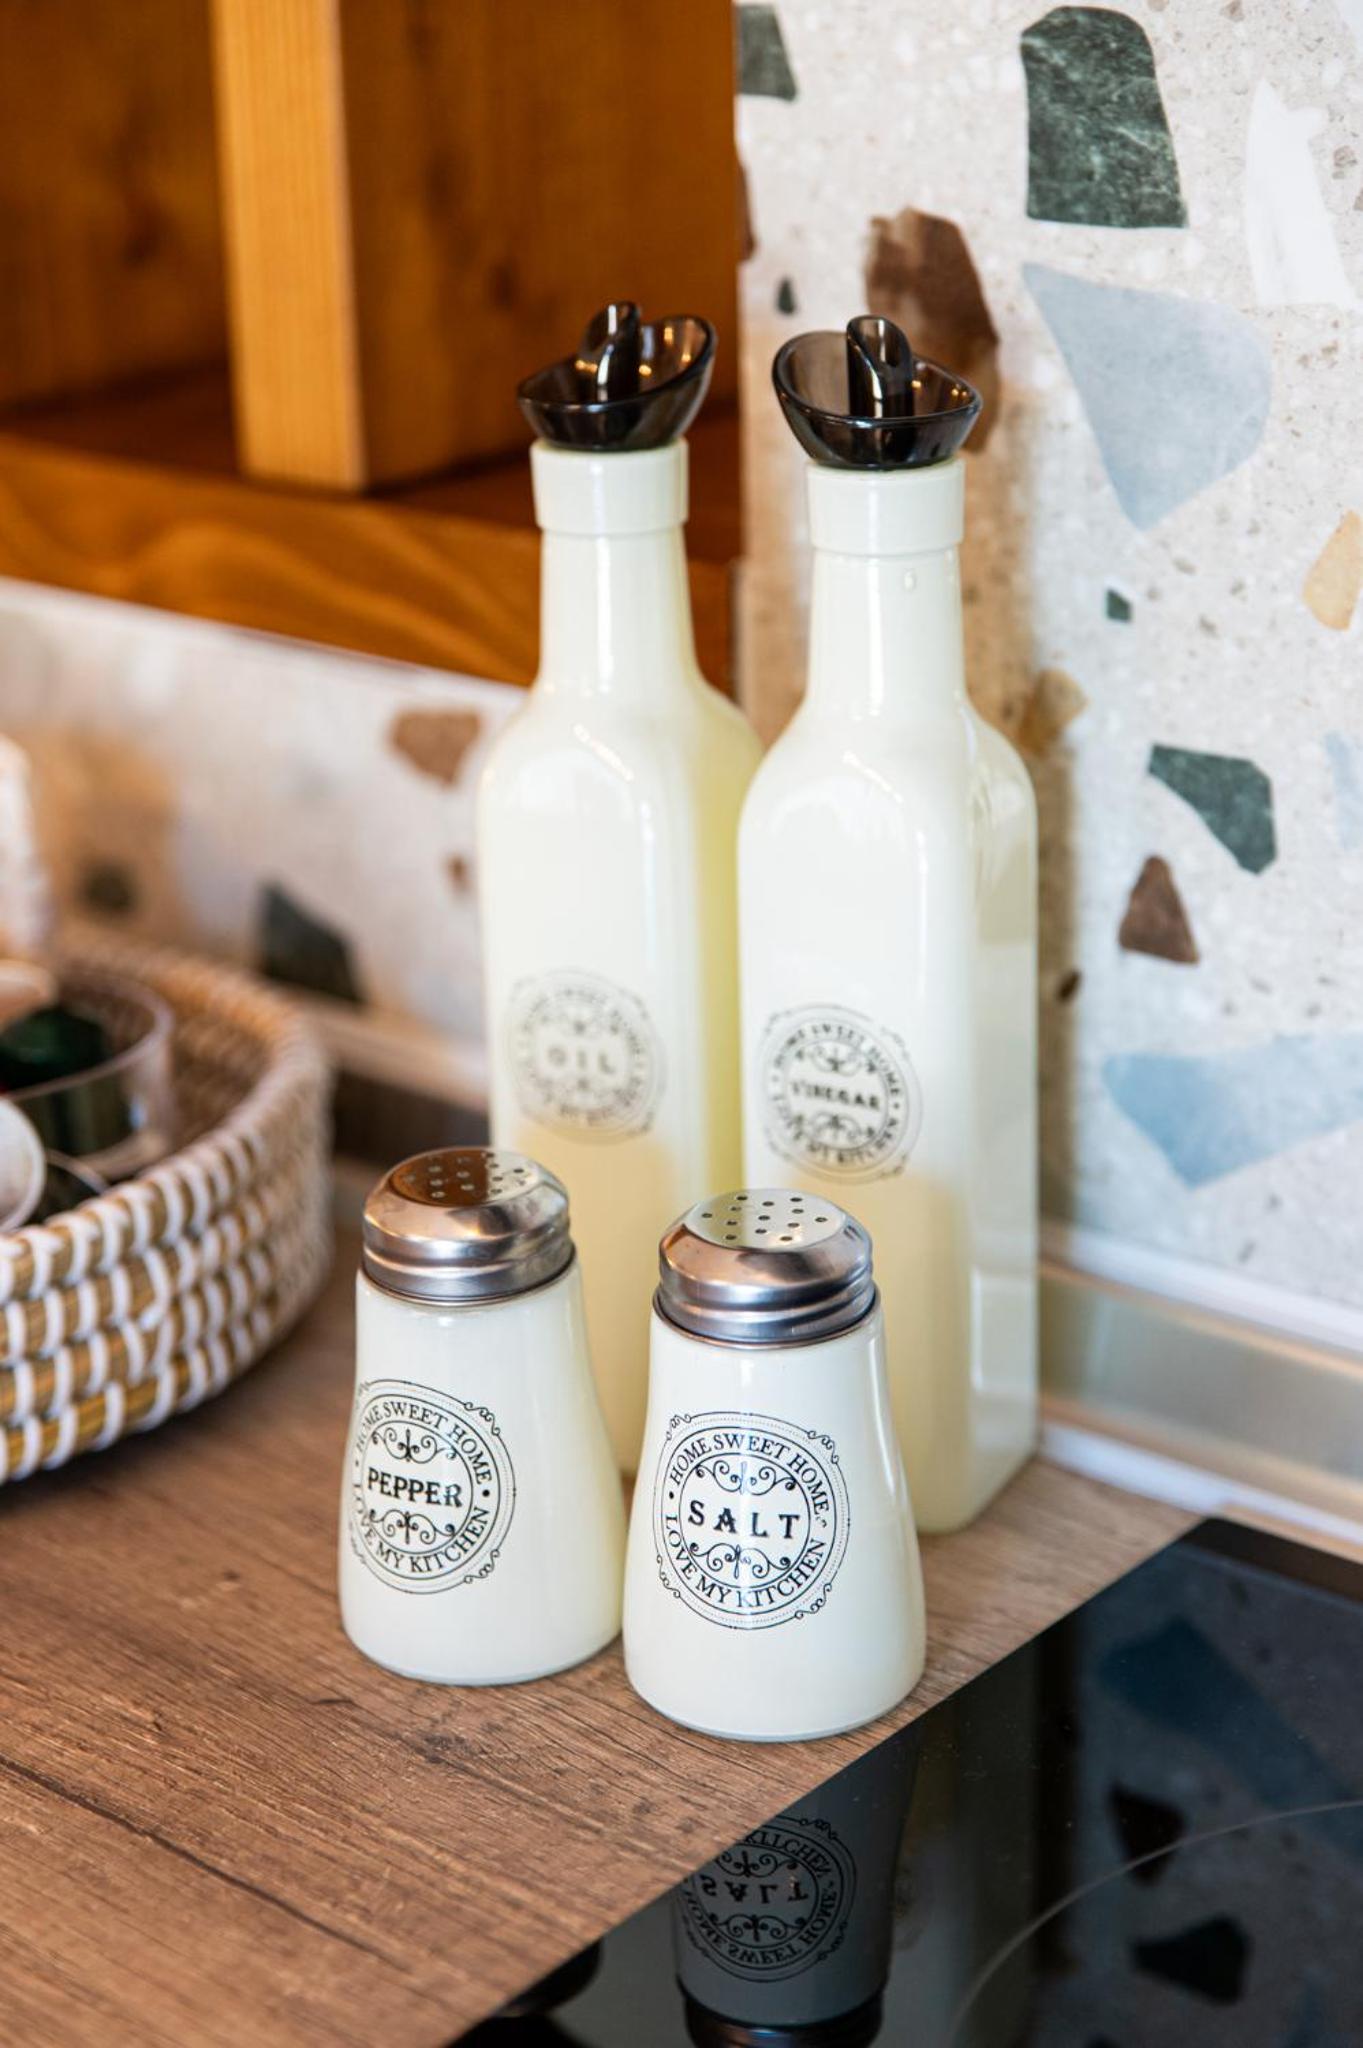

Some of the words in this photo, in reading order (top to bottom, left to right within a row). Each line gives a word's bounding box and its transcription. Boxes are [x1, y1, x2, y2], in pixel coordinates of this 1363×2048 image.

[547, 1047, 616, 1075] OIL
[382, 1400, 449, 1430] SWEET
[447, 1425, 493, 1485] HOME
[669, 1438, 713, 1486] HOME
[714, 1433, 792, 1461] SWEET
[787, 1453, 830, 1516] HOME
[367, 1467, 464, 1508] PEPPER
[688, 1500, 800, 1540] SALT
[375, 1540, 405, 1570] MY
[410, 1506, 491, 1573] KITCHEN
[665, 1514, 699, 1580] LOVE
[695, 1576, 732, 1605] MY
[736, 1538, 828, 1608] KITCHEN
